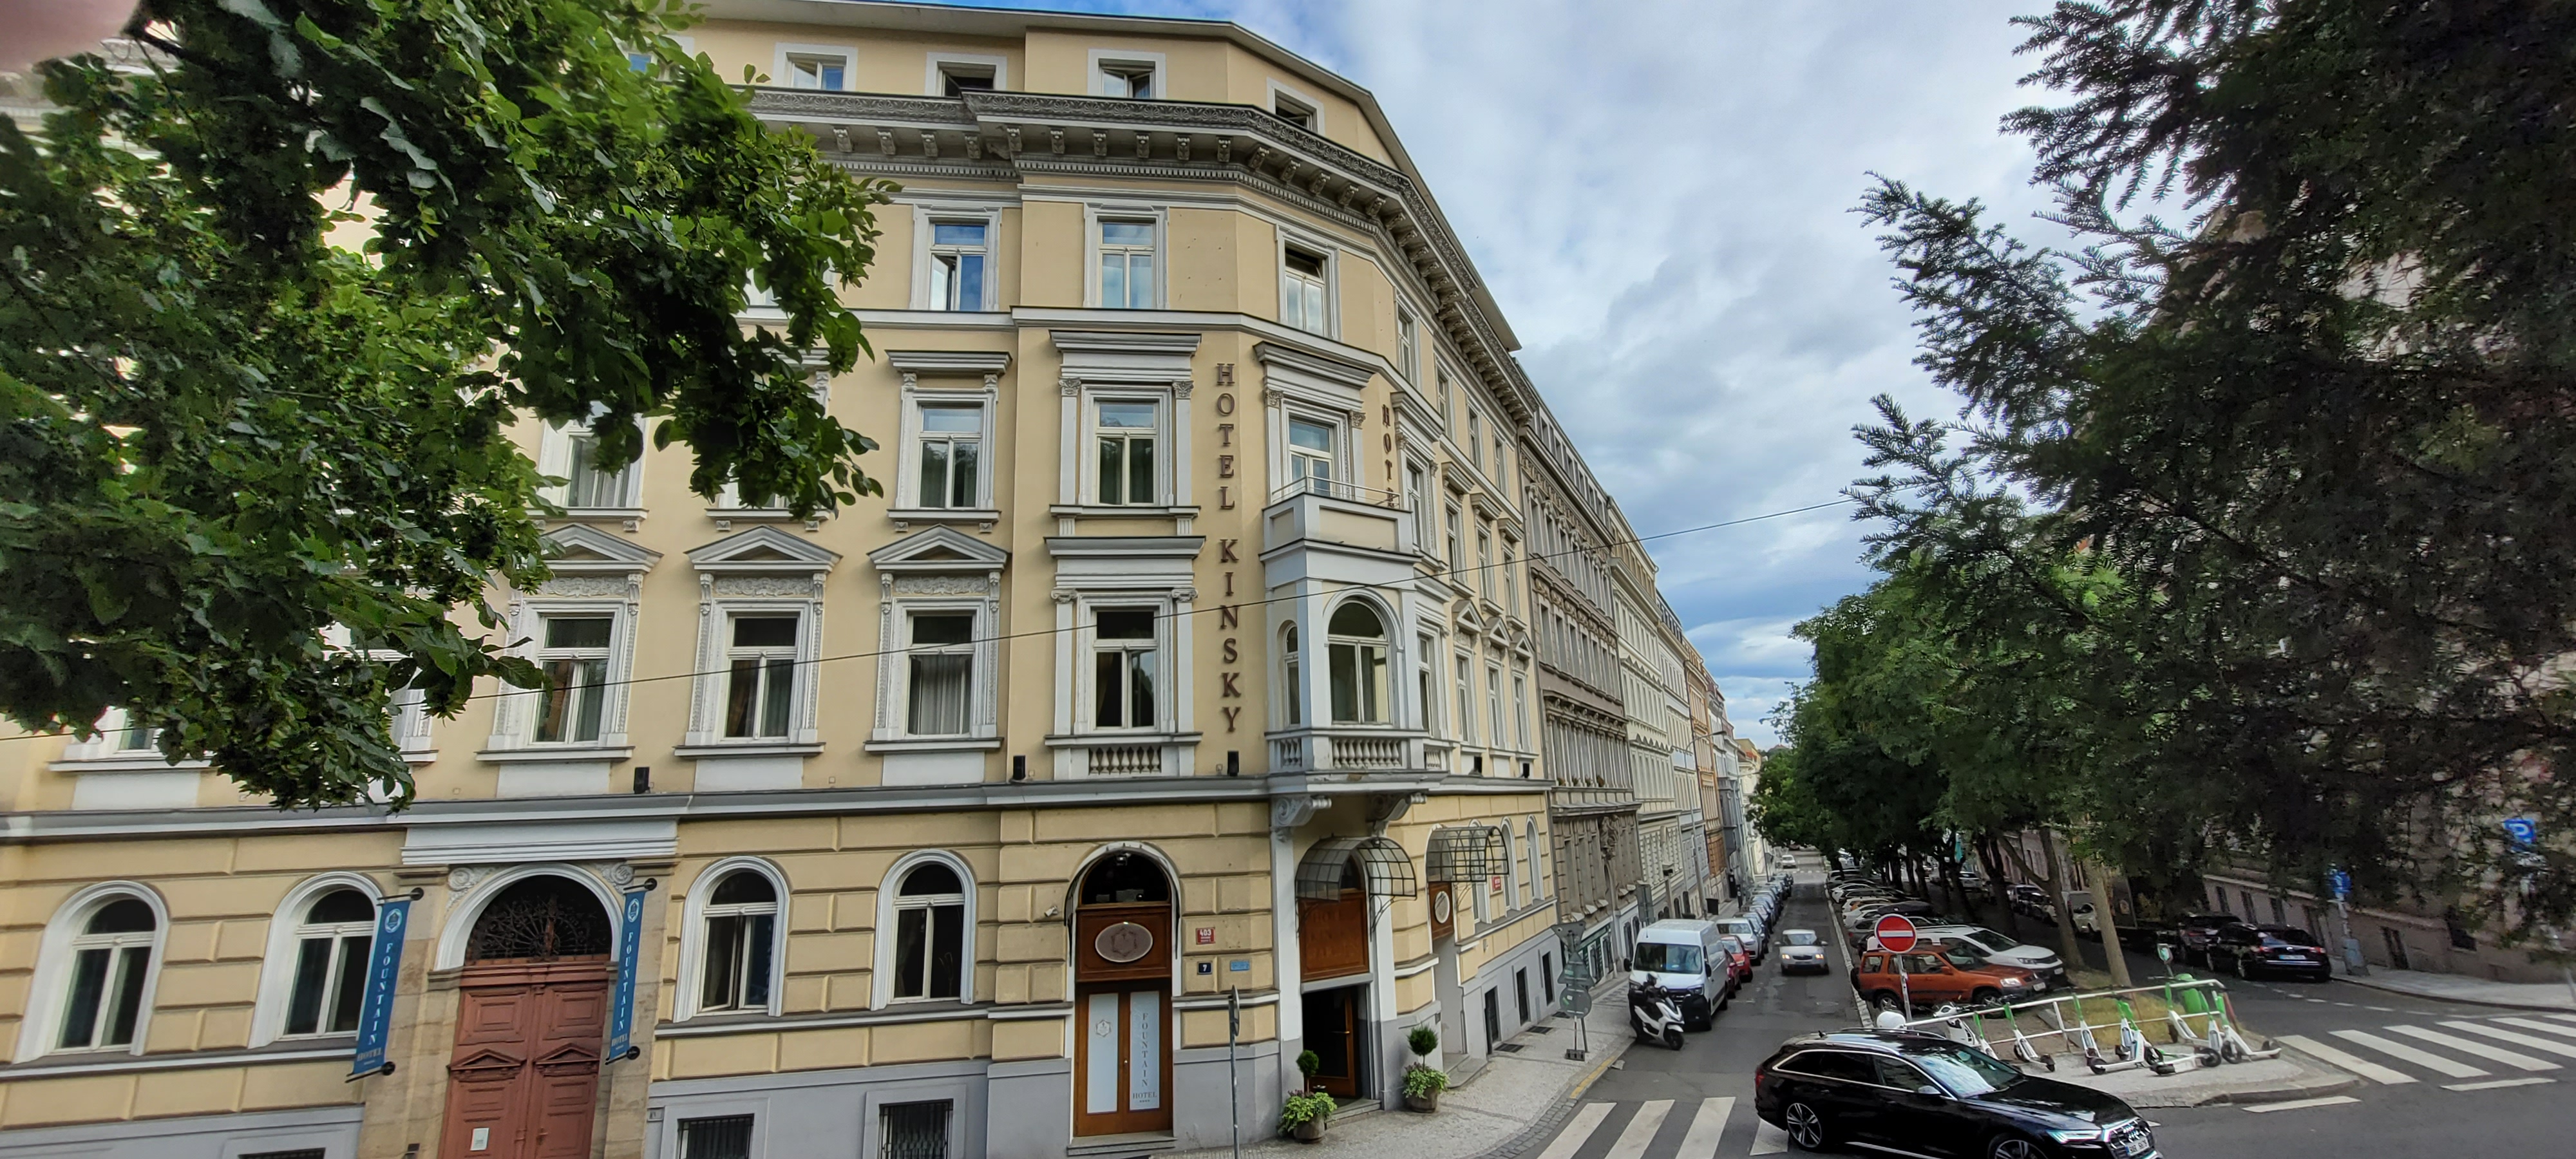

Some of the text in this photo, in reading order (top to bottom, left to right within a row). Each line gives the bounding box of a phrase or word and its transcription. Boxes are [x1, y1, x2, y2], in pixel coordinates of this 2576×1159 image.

[1217, 363, 1242, 733] HOTEL KINSKY
[368, 943, 393, 1046] FOUNTAIN
[618, 932, 634, 1032] FOUNTAIN
